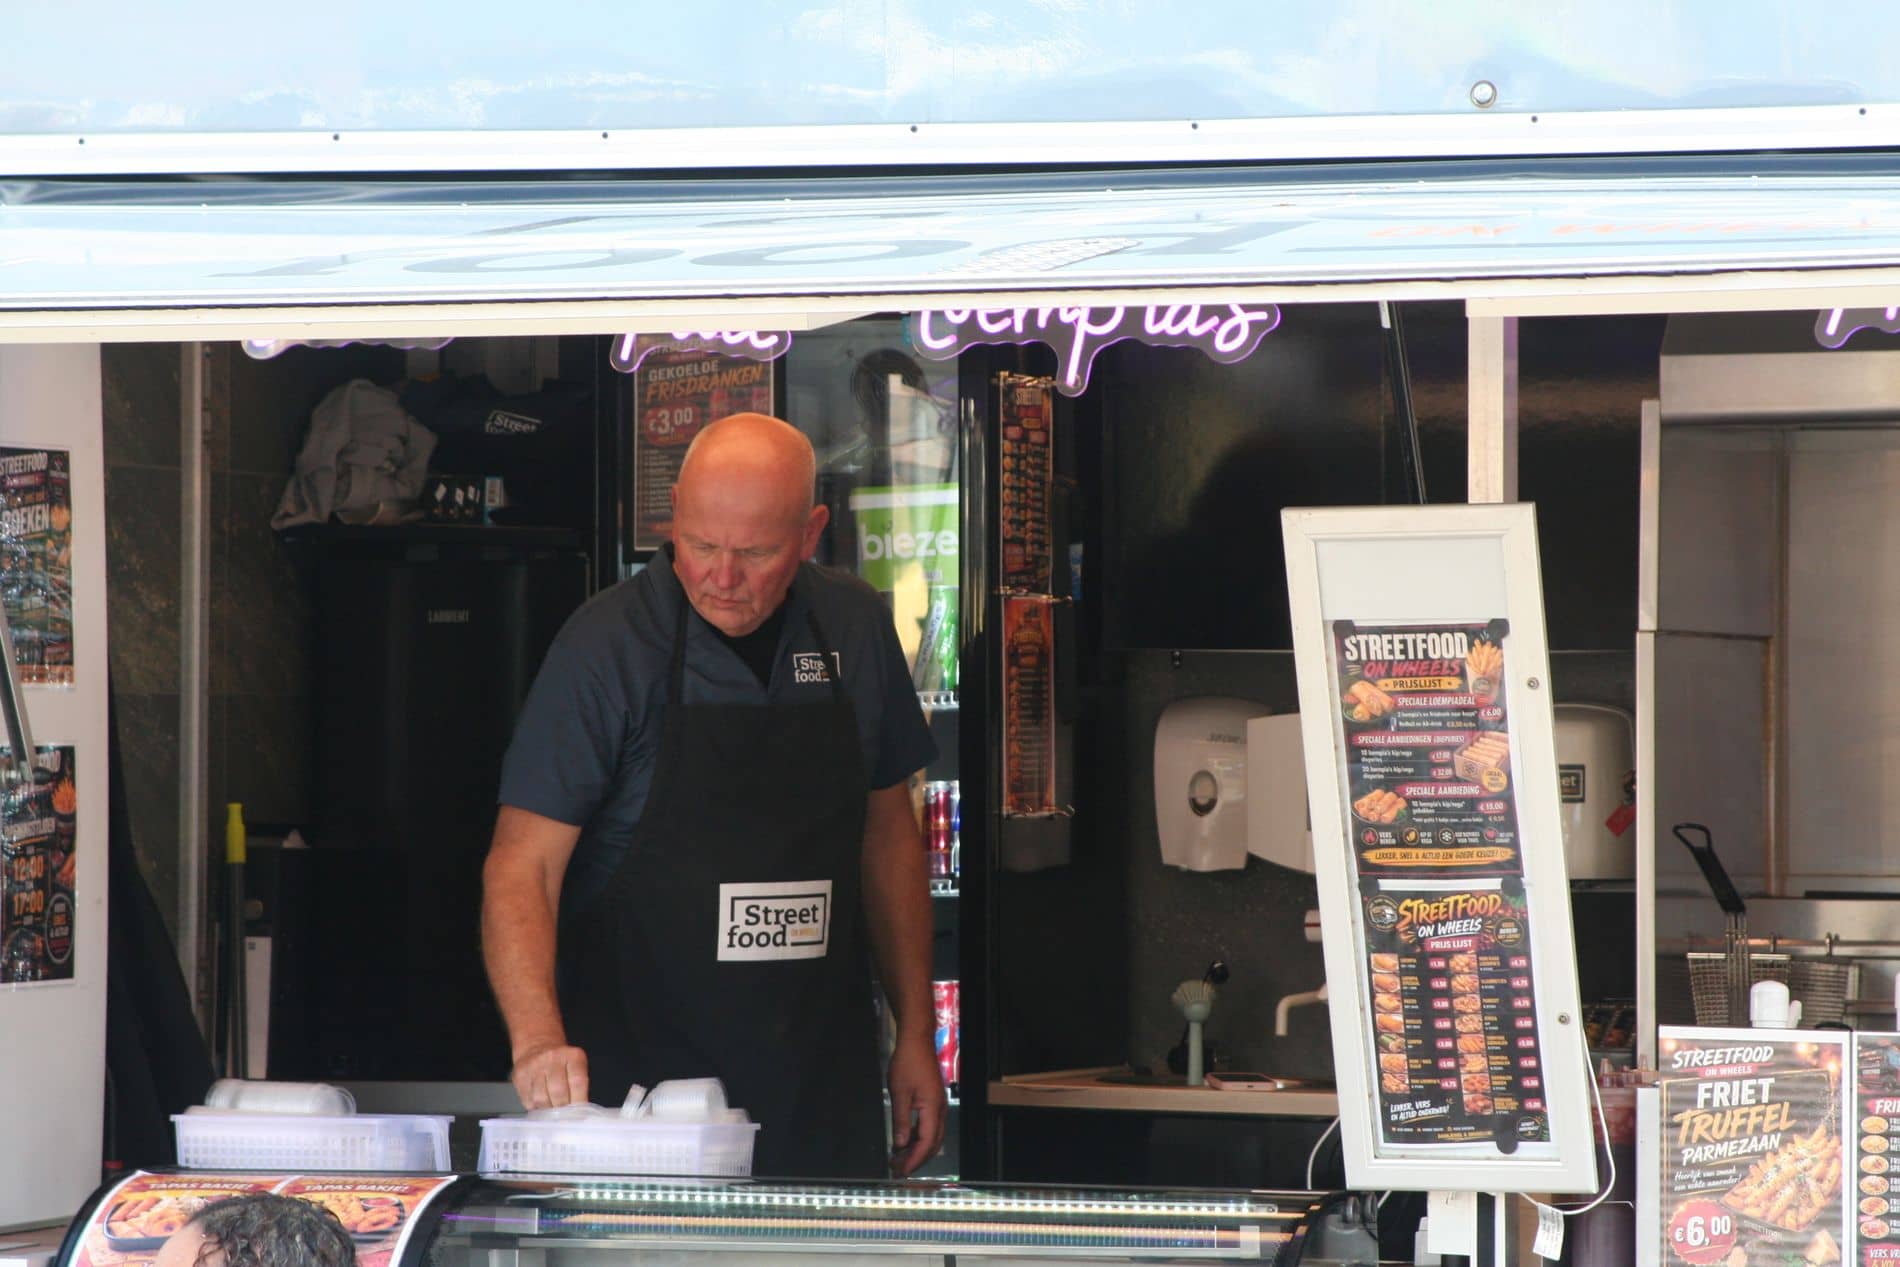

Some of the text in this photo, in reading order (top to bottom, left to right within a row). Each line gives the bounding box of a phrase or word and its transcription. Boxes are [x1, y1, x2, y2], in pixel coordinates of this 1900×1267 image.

[646, 364, 764, 403] FRISDRANKEN
[1344, 632, 1468, 661] STREETFOOD
[795, 669, 821, 683] food
[1364, 660, 1461, 677] ON WHEELS
[1393, 679, 1442, 689] PRIJSLIJST
[1398, 695, 1428, 706] SPECIALE
[1358, 735, 1385, 744] SPECIALE
[1406, 785, 1480, 796] SPECIALE AANBIEDING
[744, 903, 819, 926] Street
[1397, 893, 1502, 926] STREETFOOD
[727, 923, 787, 948] food
[1418, 924, 1435, 938] ON
[1437, 918, 1483, 937] WHEELS
[1672, 1046, 1775, 1069] STREETFOOD
[1719, 1065, 1753, 1076] WHEELS
[1696, 1077, 1775, 1109] FRIET
[1672, 1101, 1798, 1146] TRUFFEL
[1681, 1133, 1781, 1166] PARMEZAAN
